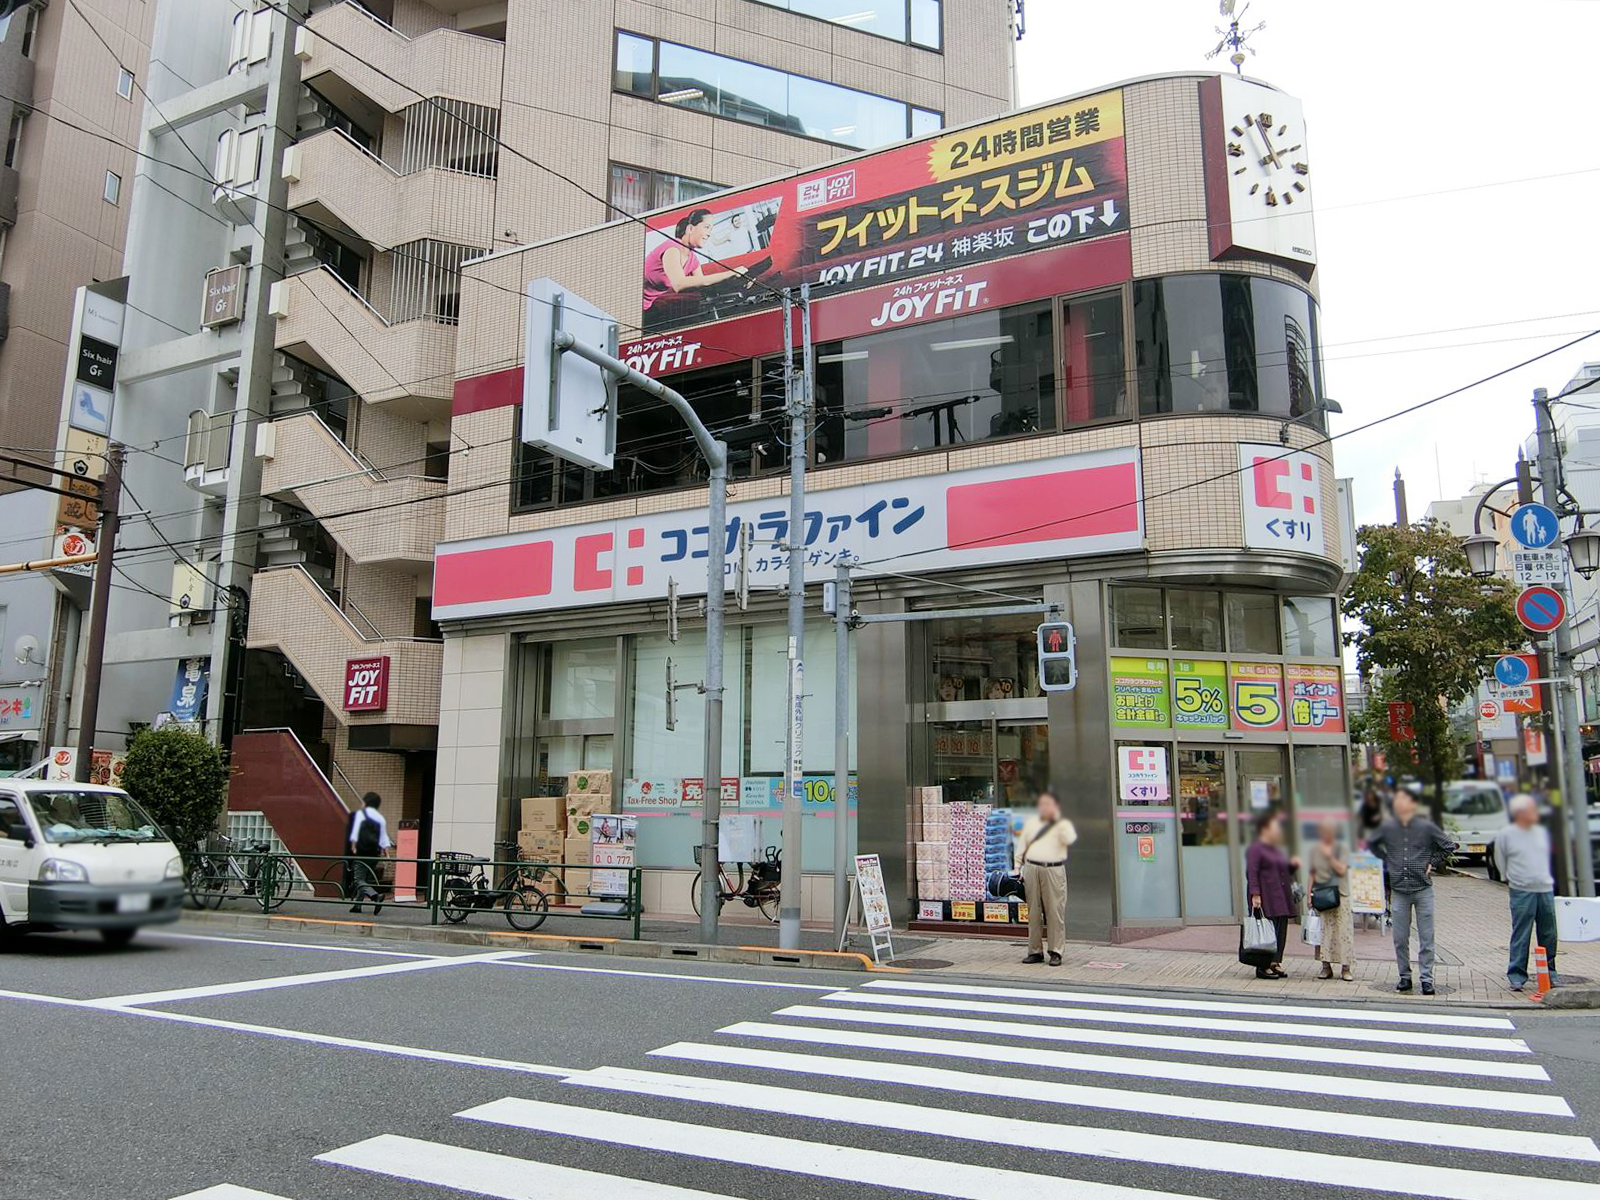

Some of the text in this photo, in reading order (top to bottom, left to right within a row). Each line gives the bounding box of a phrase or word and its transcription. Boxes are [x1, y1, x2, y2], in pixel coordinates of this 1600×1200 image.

[950, 106, 1101, 170] 24時間営業
[803, 184, 820, 197] 24
[828, 174, 852, 190] JOY
[828, 185, 850, 200] FIT
[815, 157, 1097, 256] フィットネスジム
[907, 242, 944, 269] 24
[951, 225, 1015, 258] 神楽坂
[1027, 205, 1096, 244] この下
[209, 283, 237, 297] Six hair
[893, 273, 963, 298] 24h フィットネス
[870, 291, 935, 328] JOY
[626, 335, 683, 356] 24h フィットネス
[82, 348, 113, 366] Six hair
[618, 351, 659, 375] OY
[89, 364, 103, 377] 6F
[1265, 518, 1311, 541] くすり
[348, 670, 380, 687] JOY
[1175, 678, 1224, 714] 5%
[1293, 681, 1337, 696] ポイント
[1235, 682, 1282, 727] 5
[1291, 697, 1340, 727] 倍デー
[627, 796, 678, 806] Tax-Free Shop
[685, 784, 738, 800] 免店
[1130, 786, 1158, 798] くすり
[922, 909, 934, 917] 158
